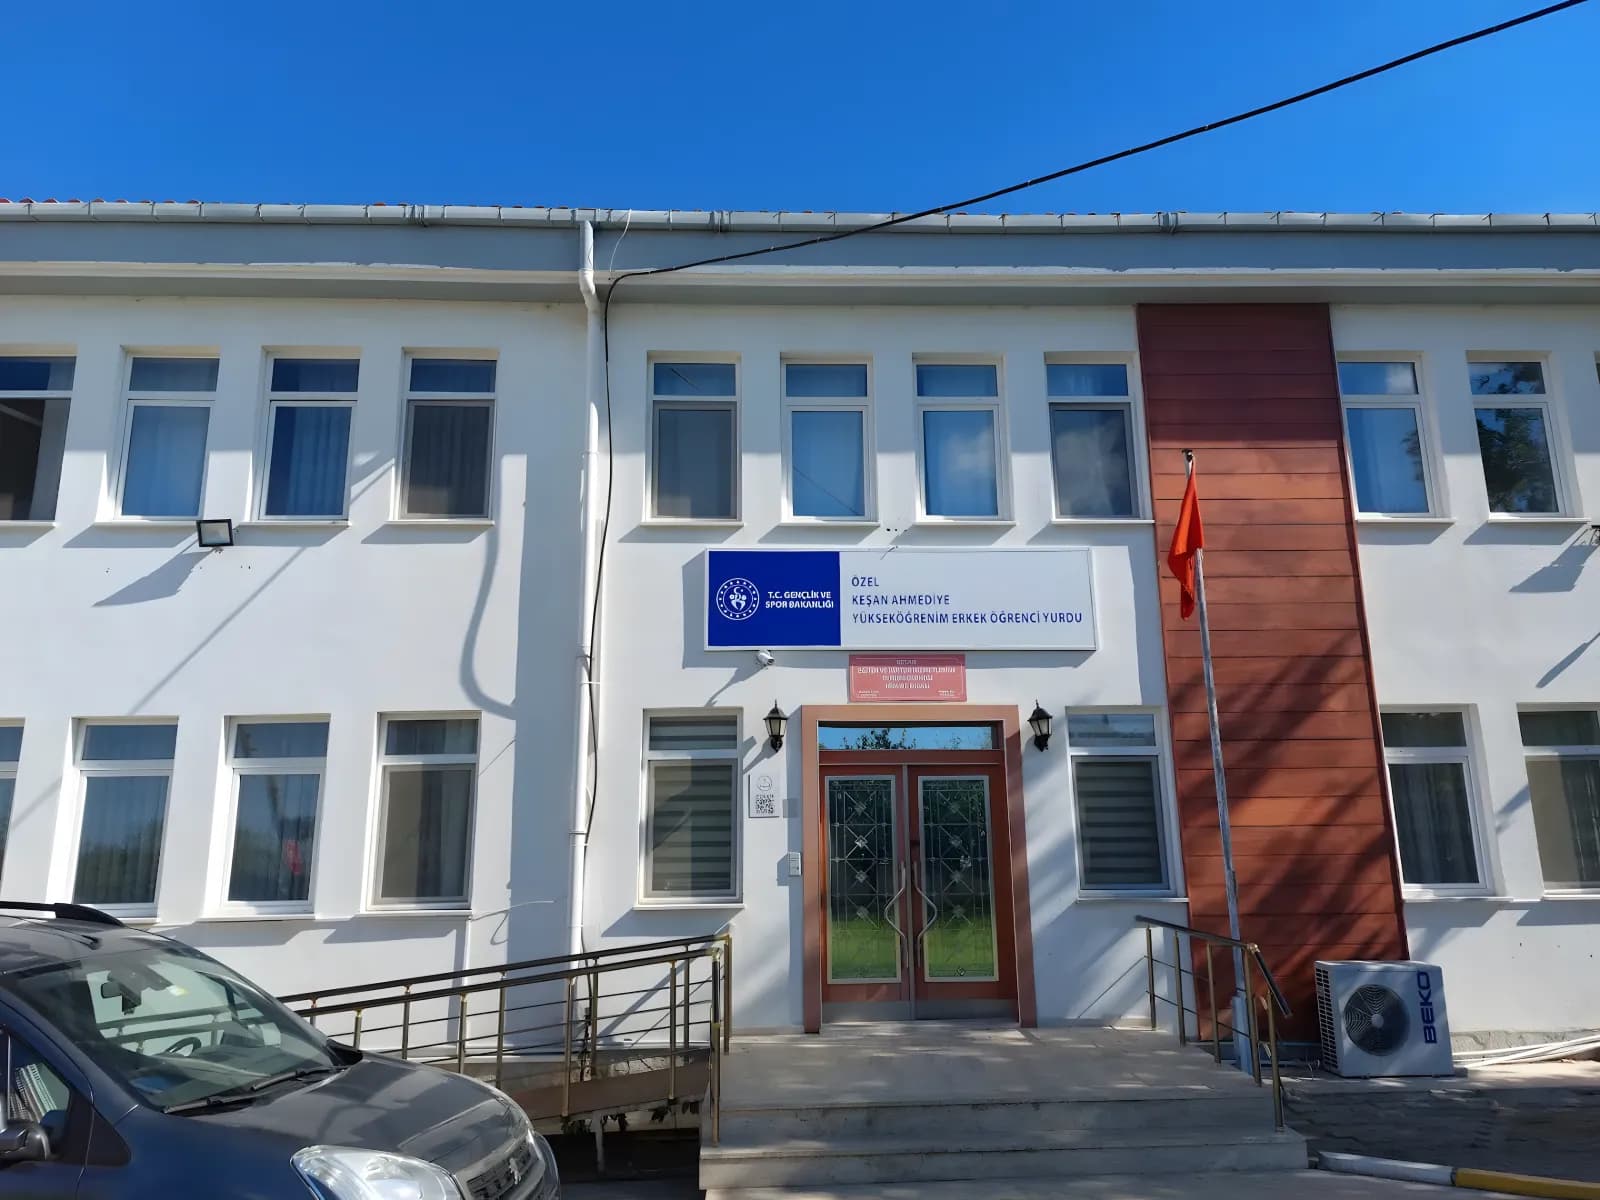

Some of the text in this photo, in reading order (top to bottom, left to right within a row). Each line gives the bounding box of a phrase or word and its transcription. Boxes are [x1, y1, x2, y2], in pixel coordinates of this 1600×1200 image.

[851, 575, 880, 587] ÖZEL
[767, 590, 832, 600] T.C. GENÇLİK VE
[852, 593, 950, 607] KEŞAN AHMEDİYE
[765, 600, 834, 609] SPOR BAKANLIĞI
[852, 611, 1082, 624] YÜKSEKÖĞRENİM ERKEK ÖĞRENCİ YURDU
[1417, 970, 1437, 1044] BEKO
